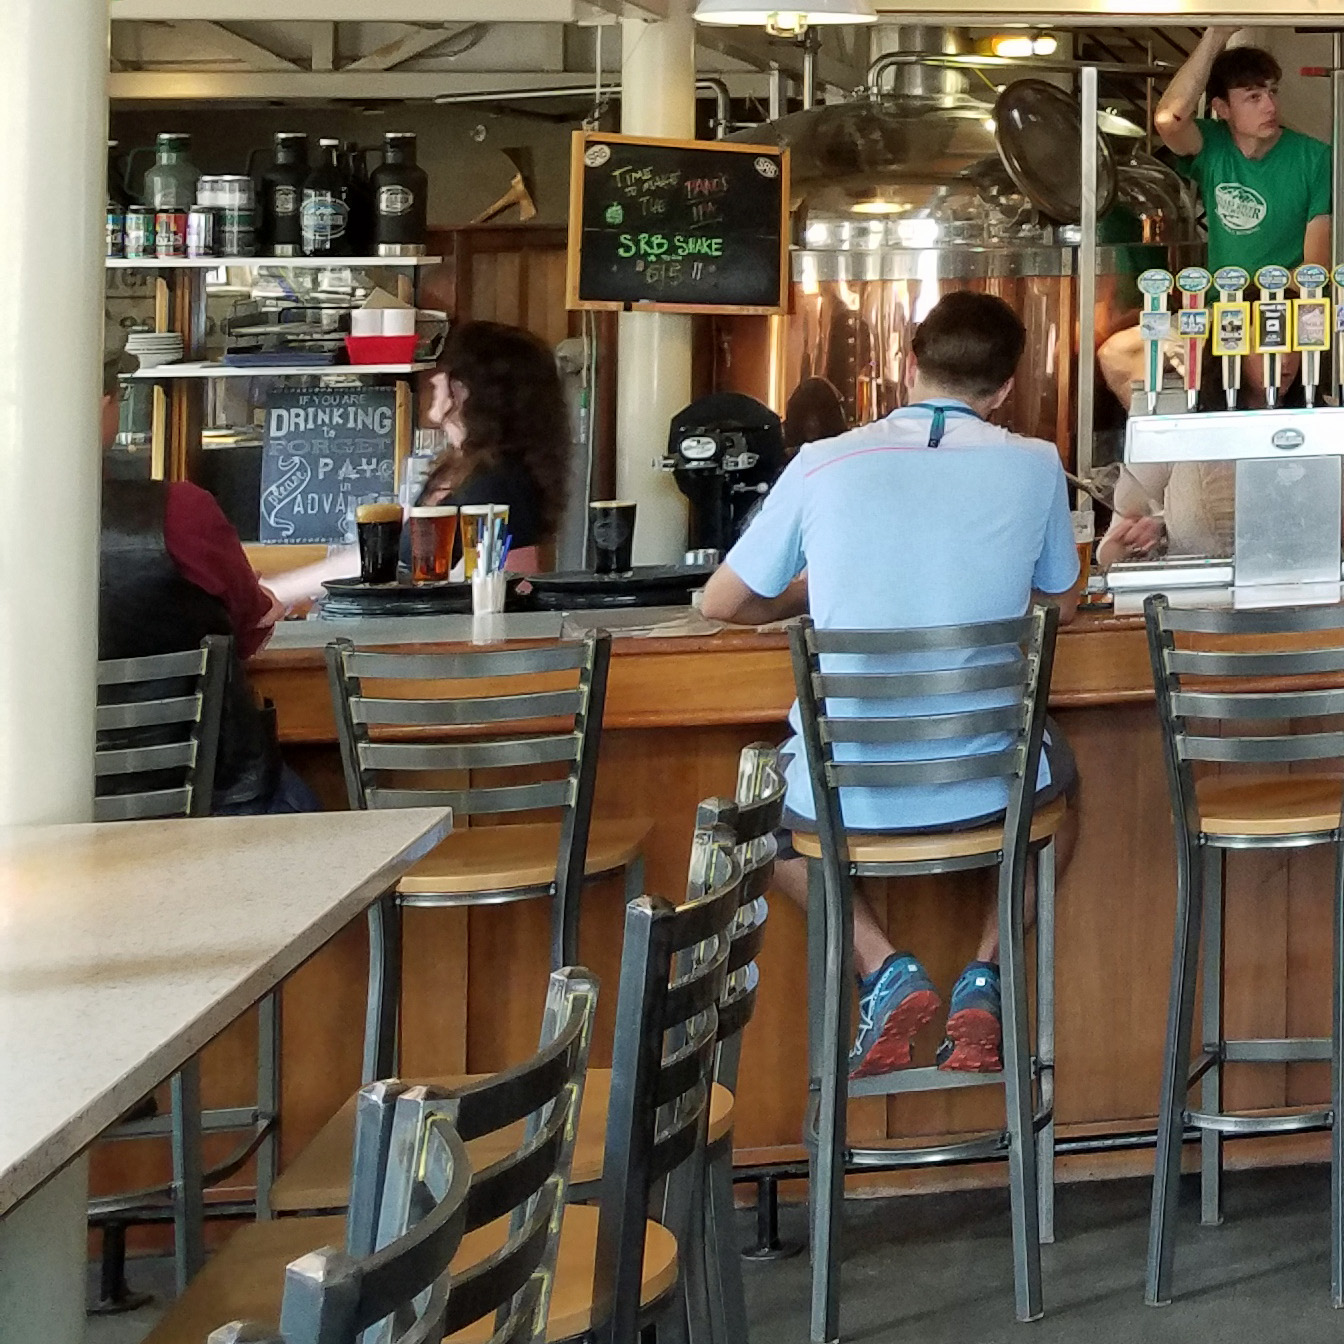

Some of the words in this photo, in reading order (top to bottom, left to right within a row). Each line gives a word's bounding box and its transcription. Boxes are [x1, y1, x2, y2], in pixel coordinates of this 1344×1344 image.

[617, 232, 669, 258] SRB
[673, 235, 724, 257] SHAKE
[299, 395, 311, 406] IF
[312, 394, 341, 406] YOU
[342, 394, 368, 405] ARE
[269, 406, 393, 438] DRINKING
[269, 438, 392, 457] FORGET
[317, 456, 378, 480] PAY
